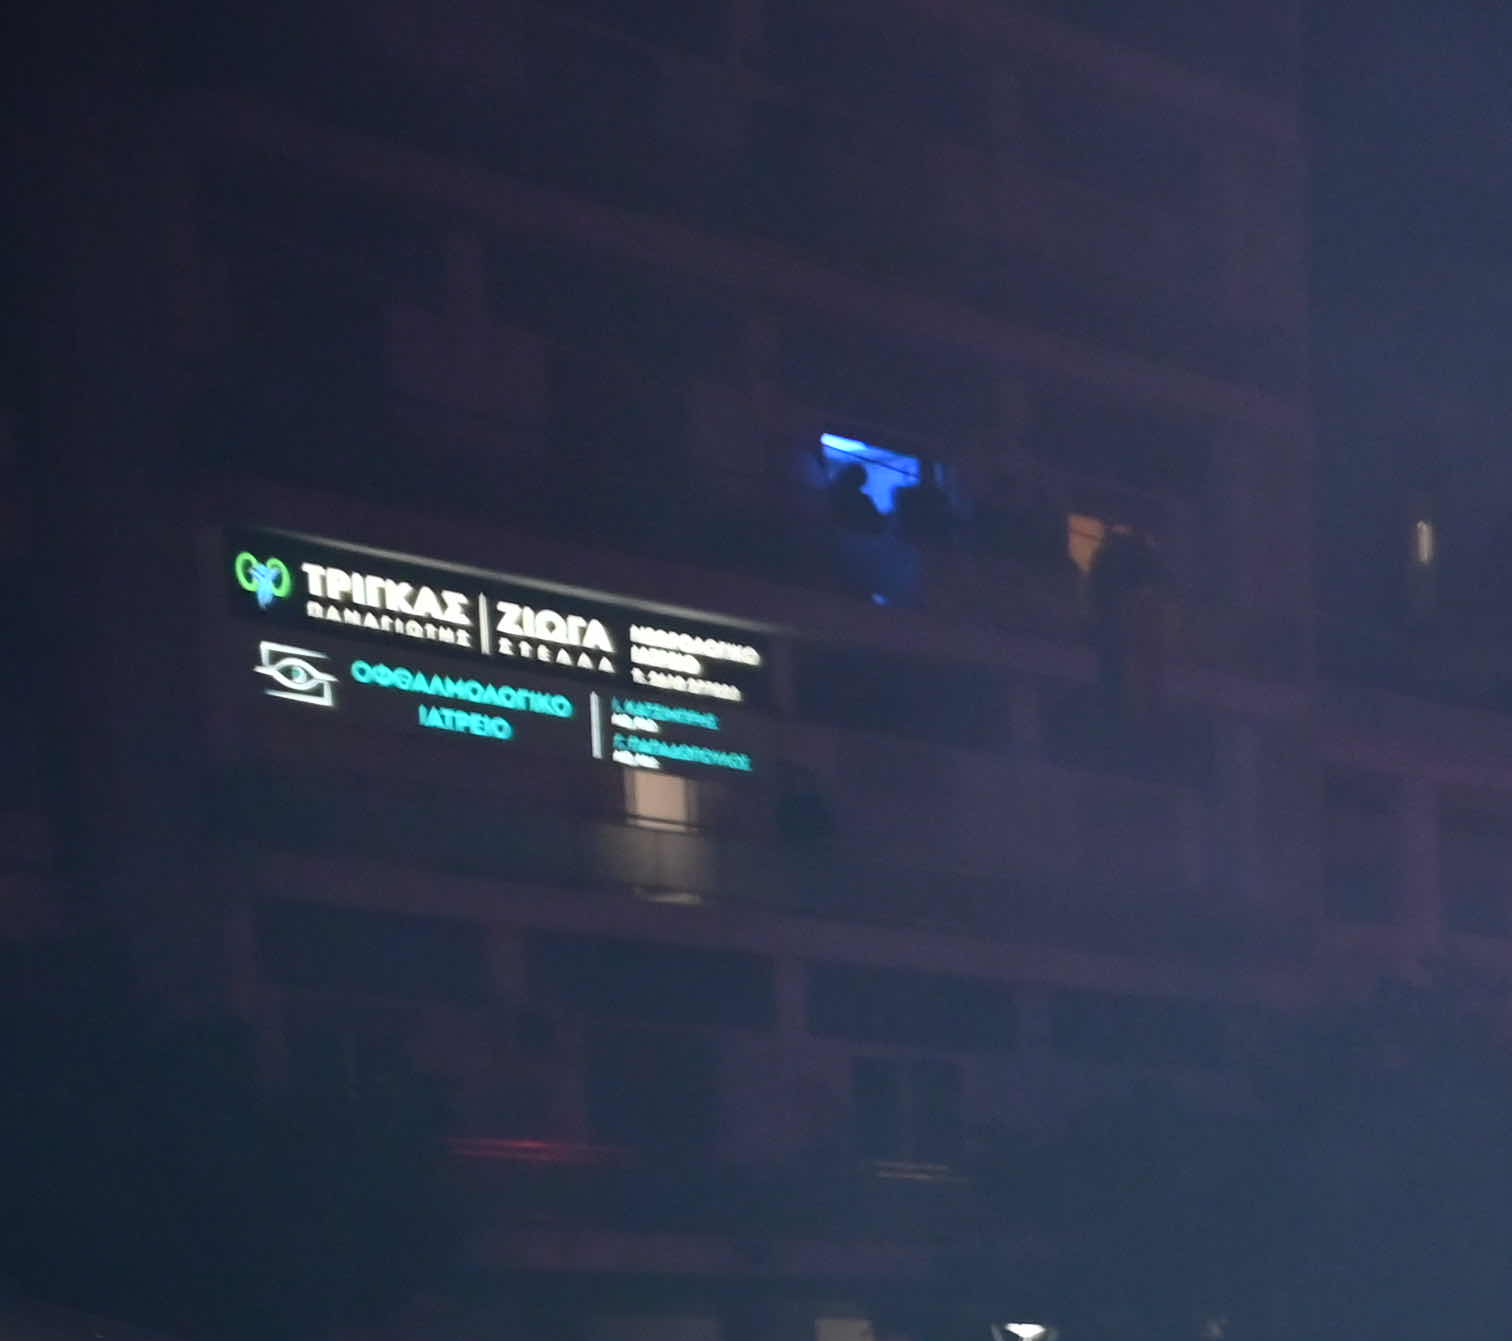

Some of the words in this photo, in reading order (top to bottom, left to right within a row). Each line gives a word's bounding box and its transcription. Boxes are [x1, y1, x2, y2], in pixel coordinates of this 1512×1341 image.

[301, 562, 472, 626] ΤΡΙΓΚΑΣ
[306, 600, 472, 648] ΠΑΝΑΓΙΩΤΗΣ
[498, 637, 616, 674] ΣΤΕΛΛΑ
[351, 659, 573, 718] ΟΦΘΑΛΜΟΛΟΓΙΚΟ
[418, 704, 513, 740] ΙΑΤΡΕΙΟ
